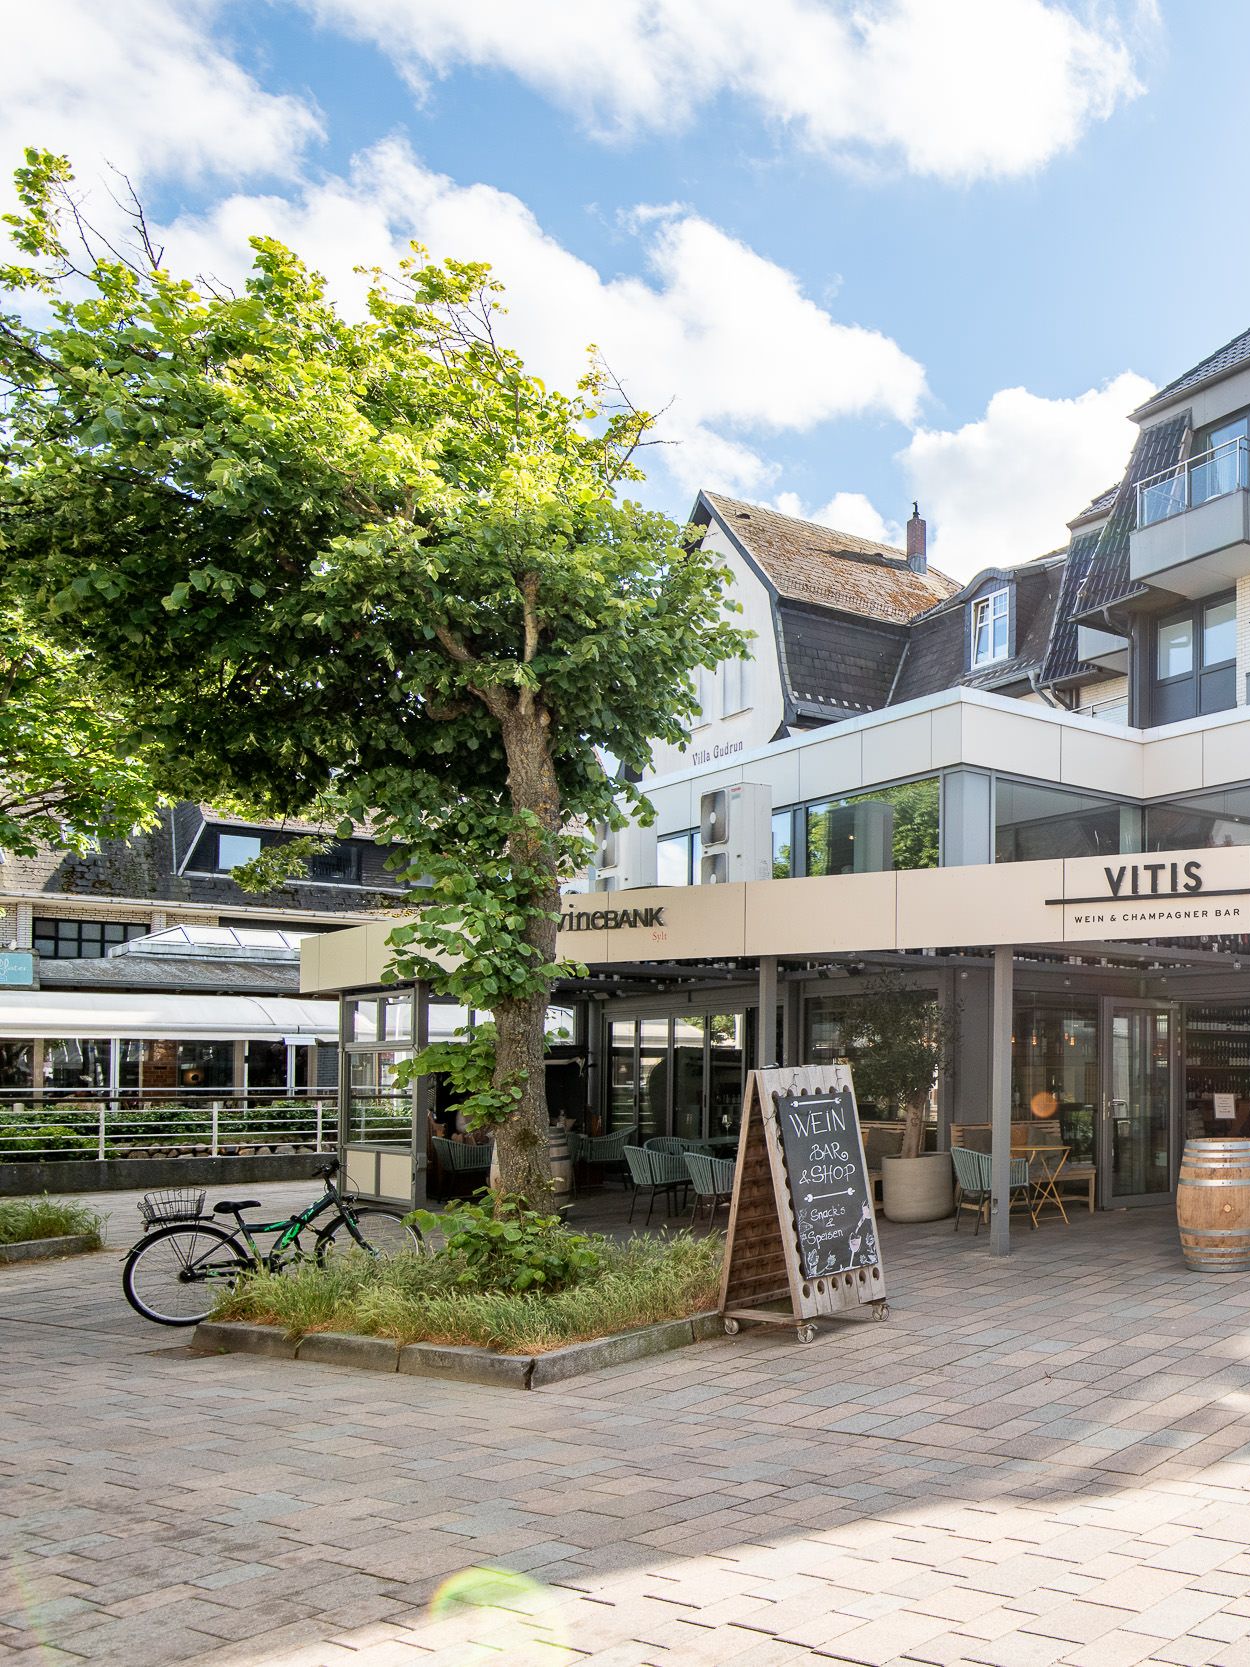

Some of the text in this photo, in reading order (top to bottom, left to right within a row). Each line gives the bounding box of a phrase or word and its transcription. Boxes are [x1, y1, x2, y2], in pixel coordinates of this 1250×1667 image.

[692, 741, 743, 766] Villa Gudrun
[1104, 861, 1202, 896] VITIS
[1074, 908, 1241, 923] WEIN & CHAMPAGNER BAR
[652, 931, 667, 942] Sylt
[789, 1108, 846, 1138] WEIN
[809, 1141, 848, 1162] BAR
[825, 1217, 836, 1227] &
[807, 1229, 844, 1249] Speisen
